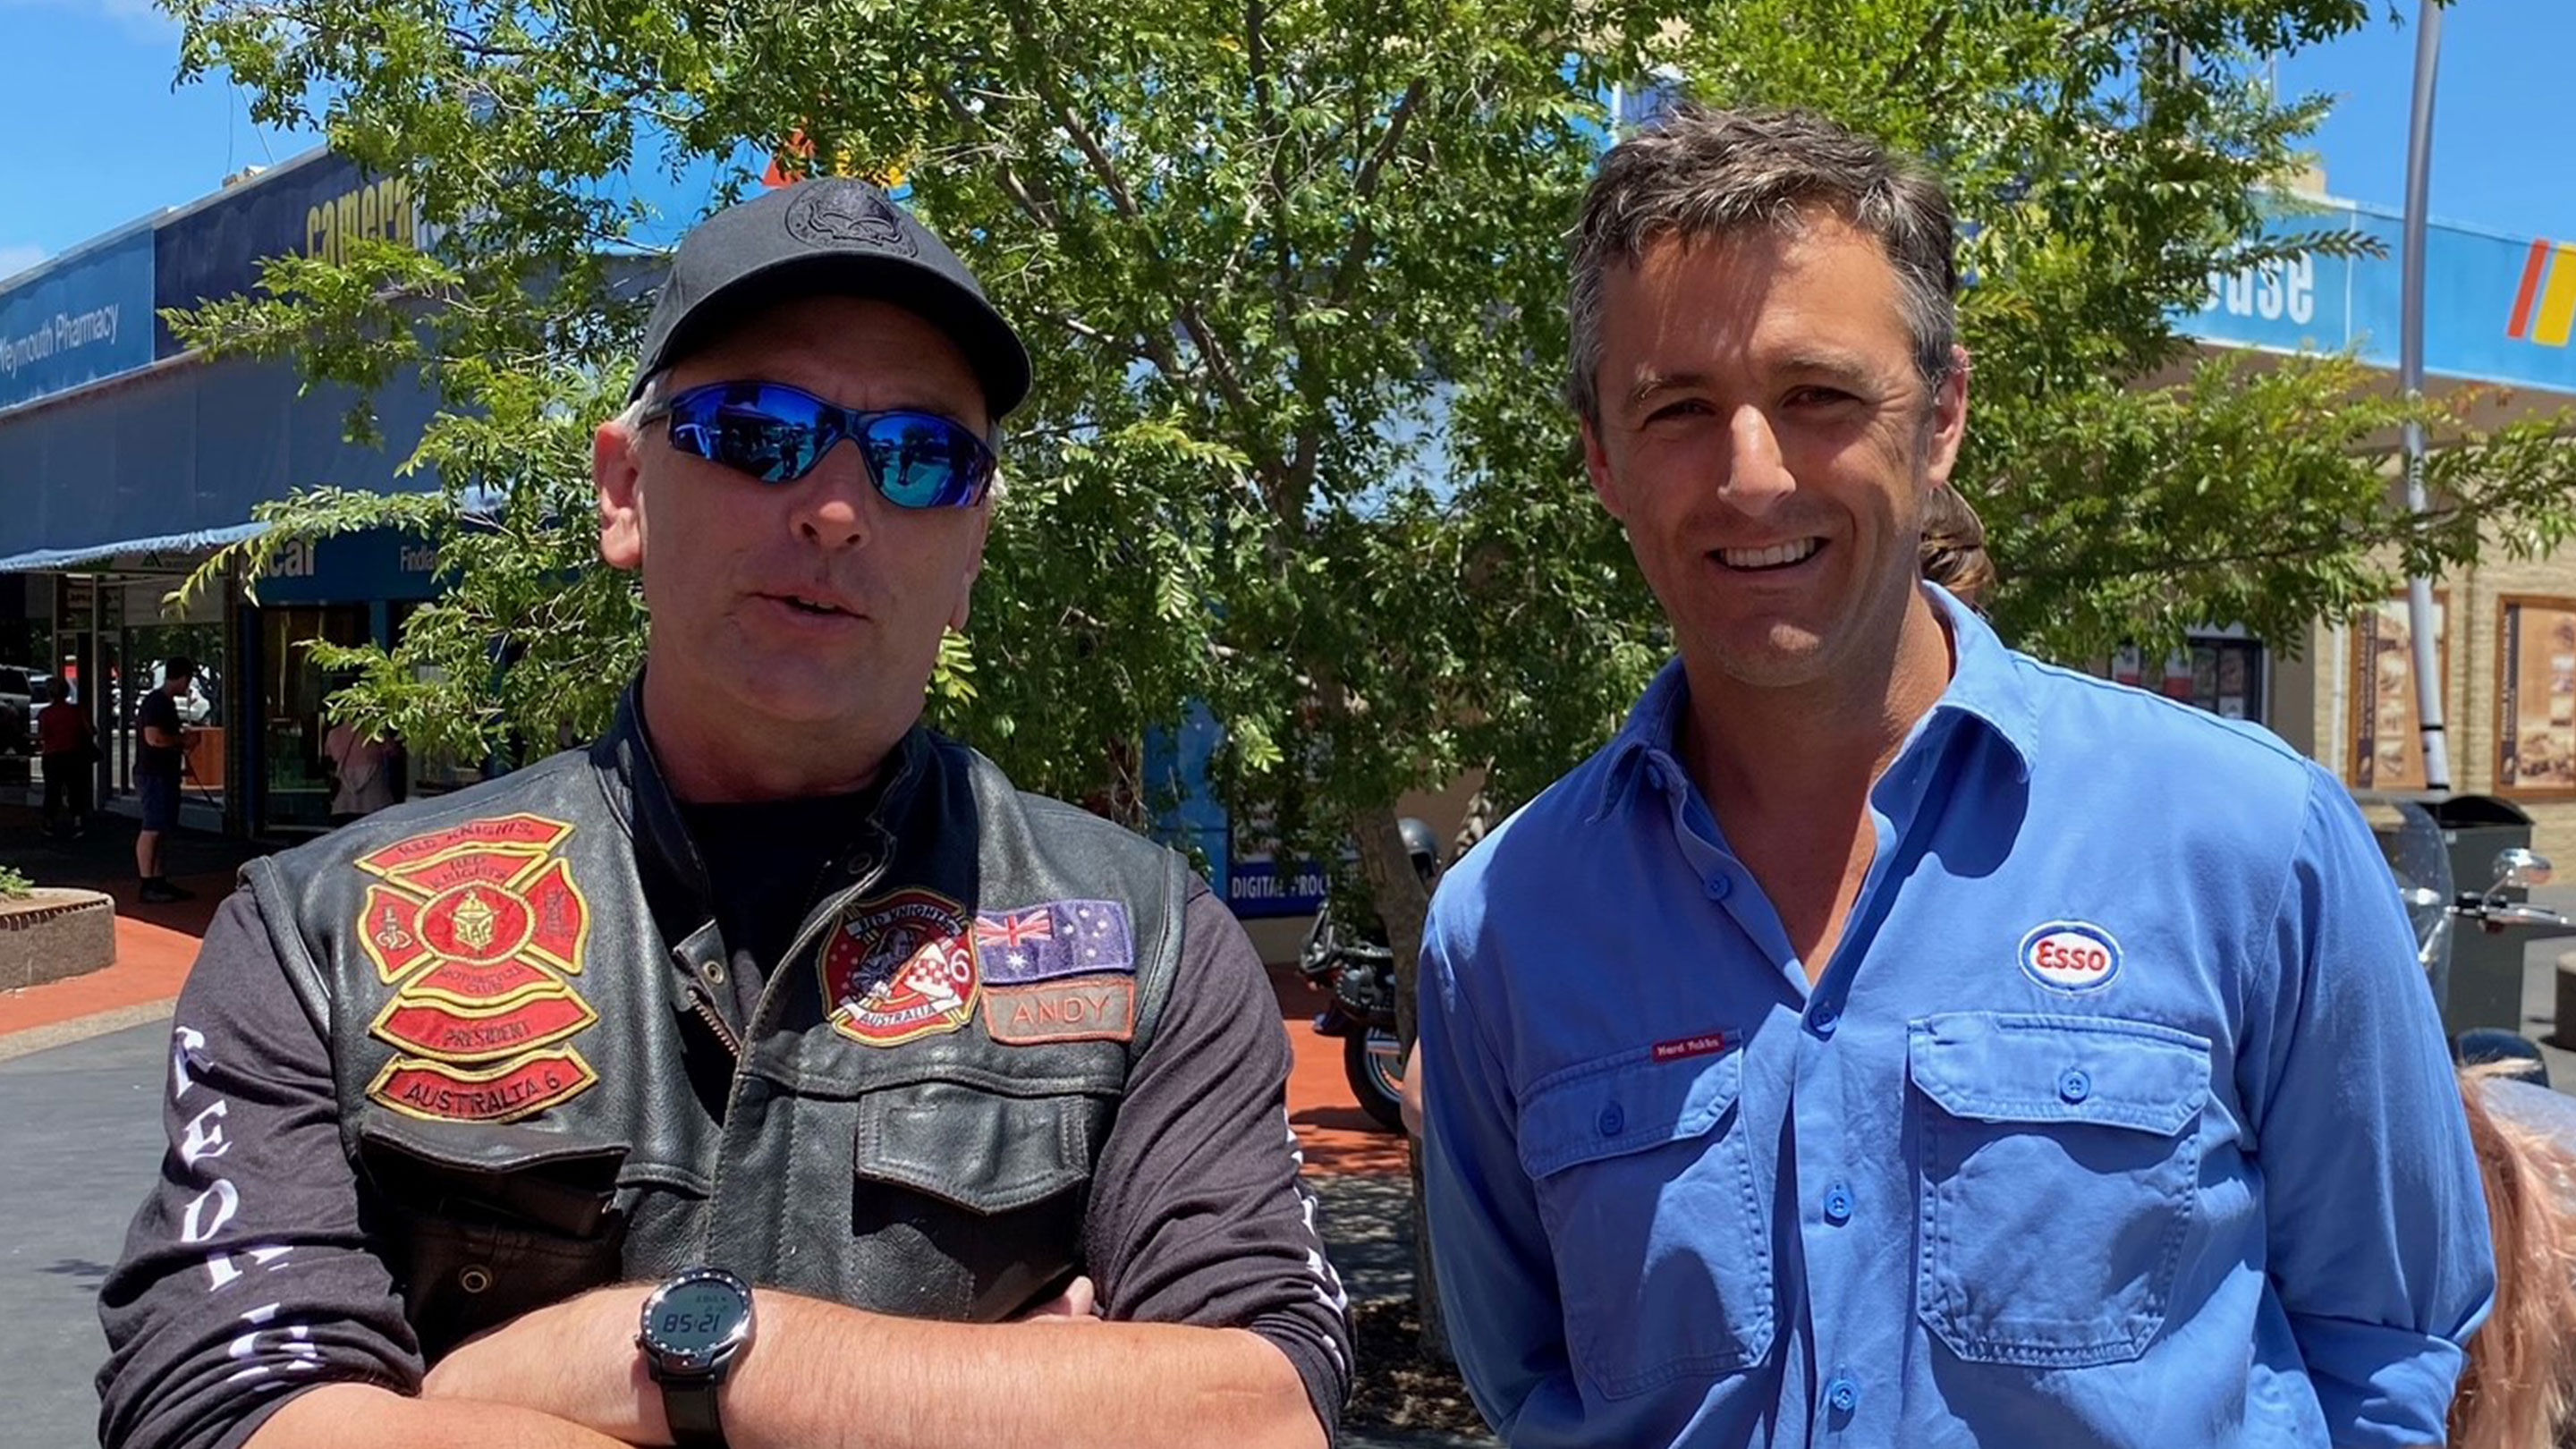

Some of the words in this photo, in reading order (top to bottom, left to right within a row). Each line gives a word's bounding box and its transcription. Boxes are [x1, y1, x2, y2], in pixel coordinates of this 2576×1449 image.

[55, 303, 119, 353] Pharmacy
[888, 904, 952, 926] KNIGHTS
[951, 949, 970, 983] 6
[859, 1004, 938, 1025] AUSTRALIA
[1013, 996, 1109, 1026] ANDY
[443, 1021, 530, 1046] PRESIDENT
[403, 1079, 540, 1114] AUSTRALIA
[545, 1070, 561, 1089] 6
